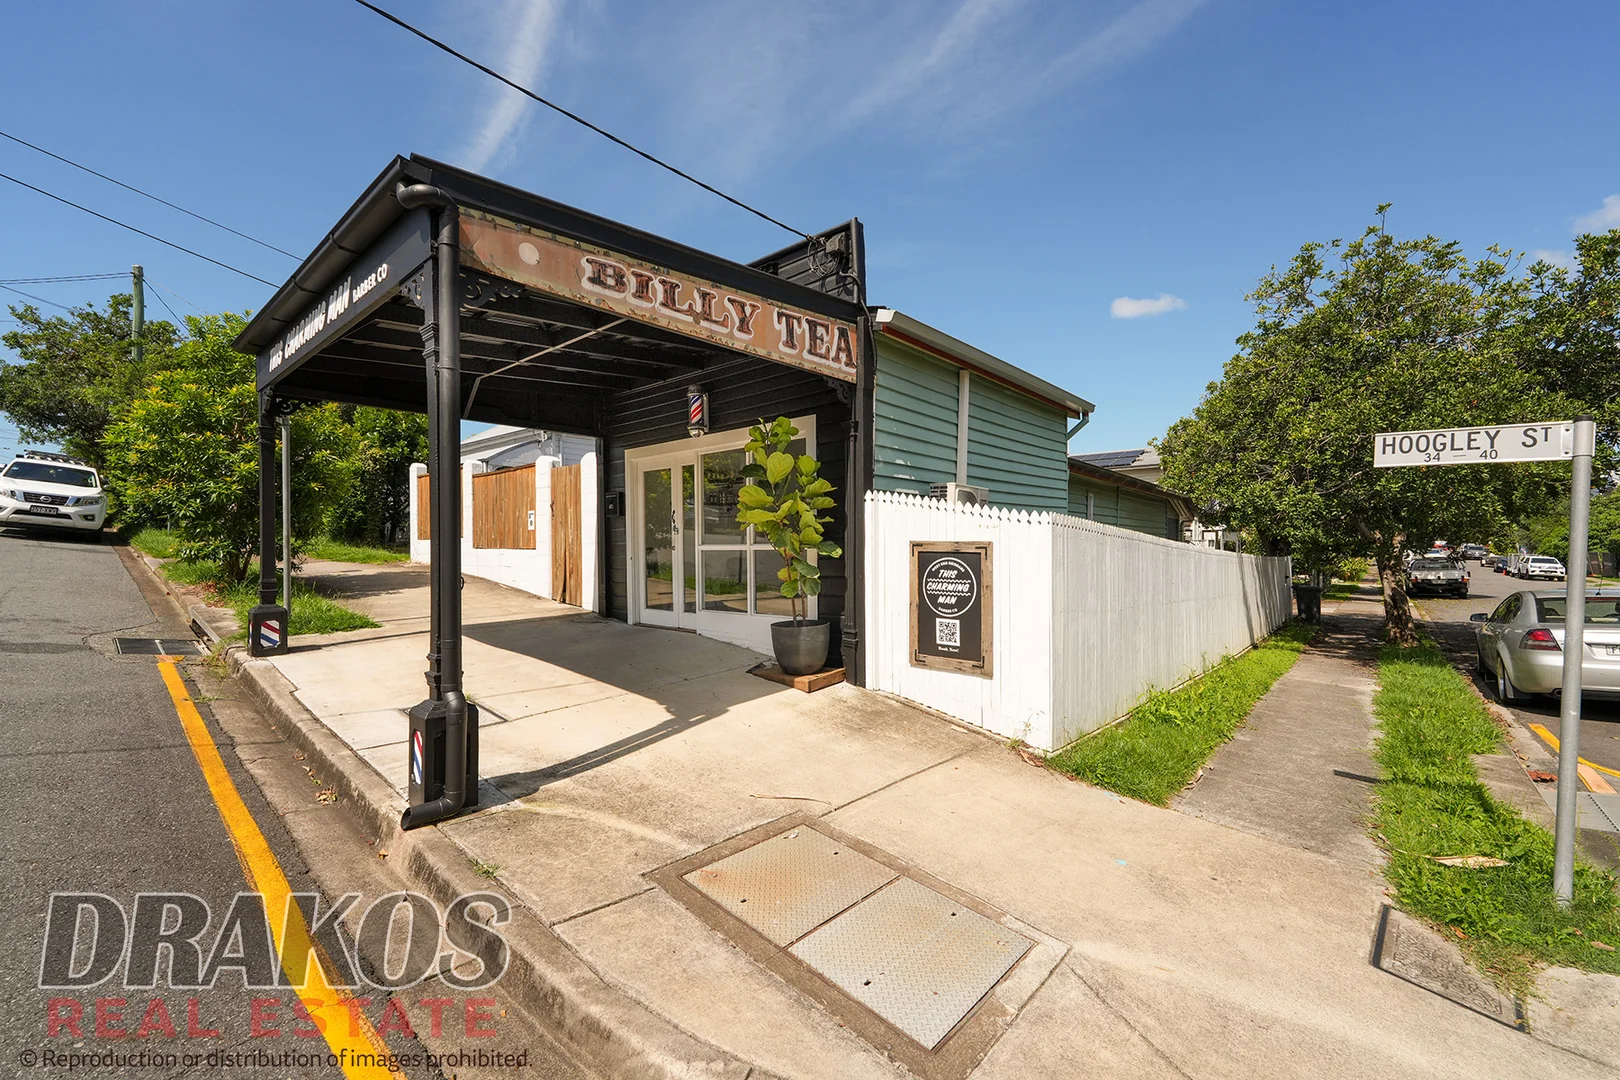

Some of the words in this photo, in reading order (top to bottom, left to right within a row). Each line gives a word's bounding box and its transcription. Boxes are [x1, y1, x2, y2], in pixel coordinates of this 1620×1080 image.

[352, 273, 377, 303] BARBER
[377, 263, 388, 282] CO
[269, 340, 284, 373] THIS
[284, 300, 327, 359] CHARMING
[327, 276, 351, 324] MAN
[581, 256, 762, 340] BILLY
[773, 308, 857, 373] TEA
[1381, 429, 1501, 455] HOOGLEY
[1521, 427, 1552, 448] ST
[1424, 452, 1441, 462] 34
[1479, 449, 1498, 460] 40
[938, 569, 958, 579] THIS
[926, 582, 970, 592] CHARMING
[937, 595, 958, 605] MAN
